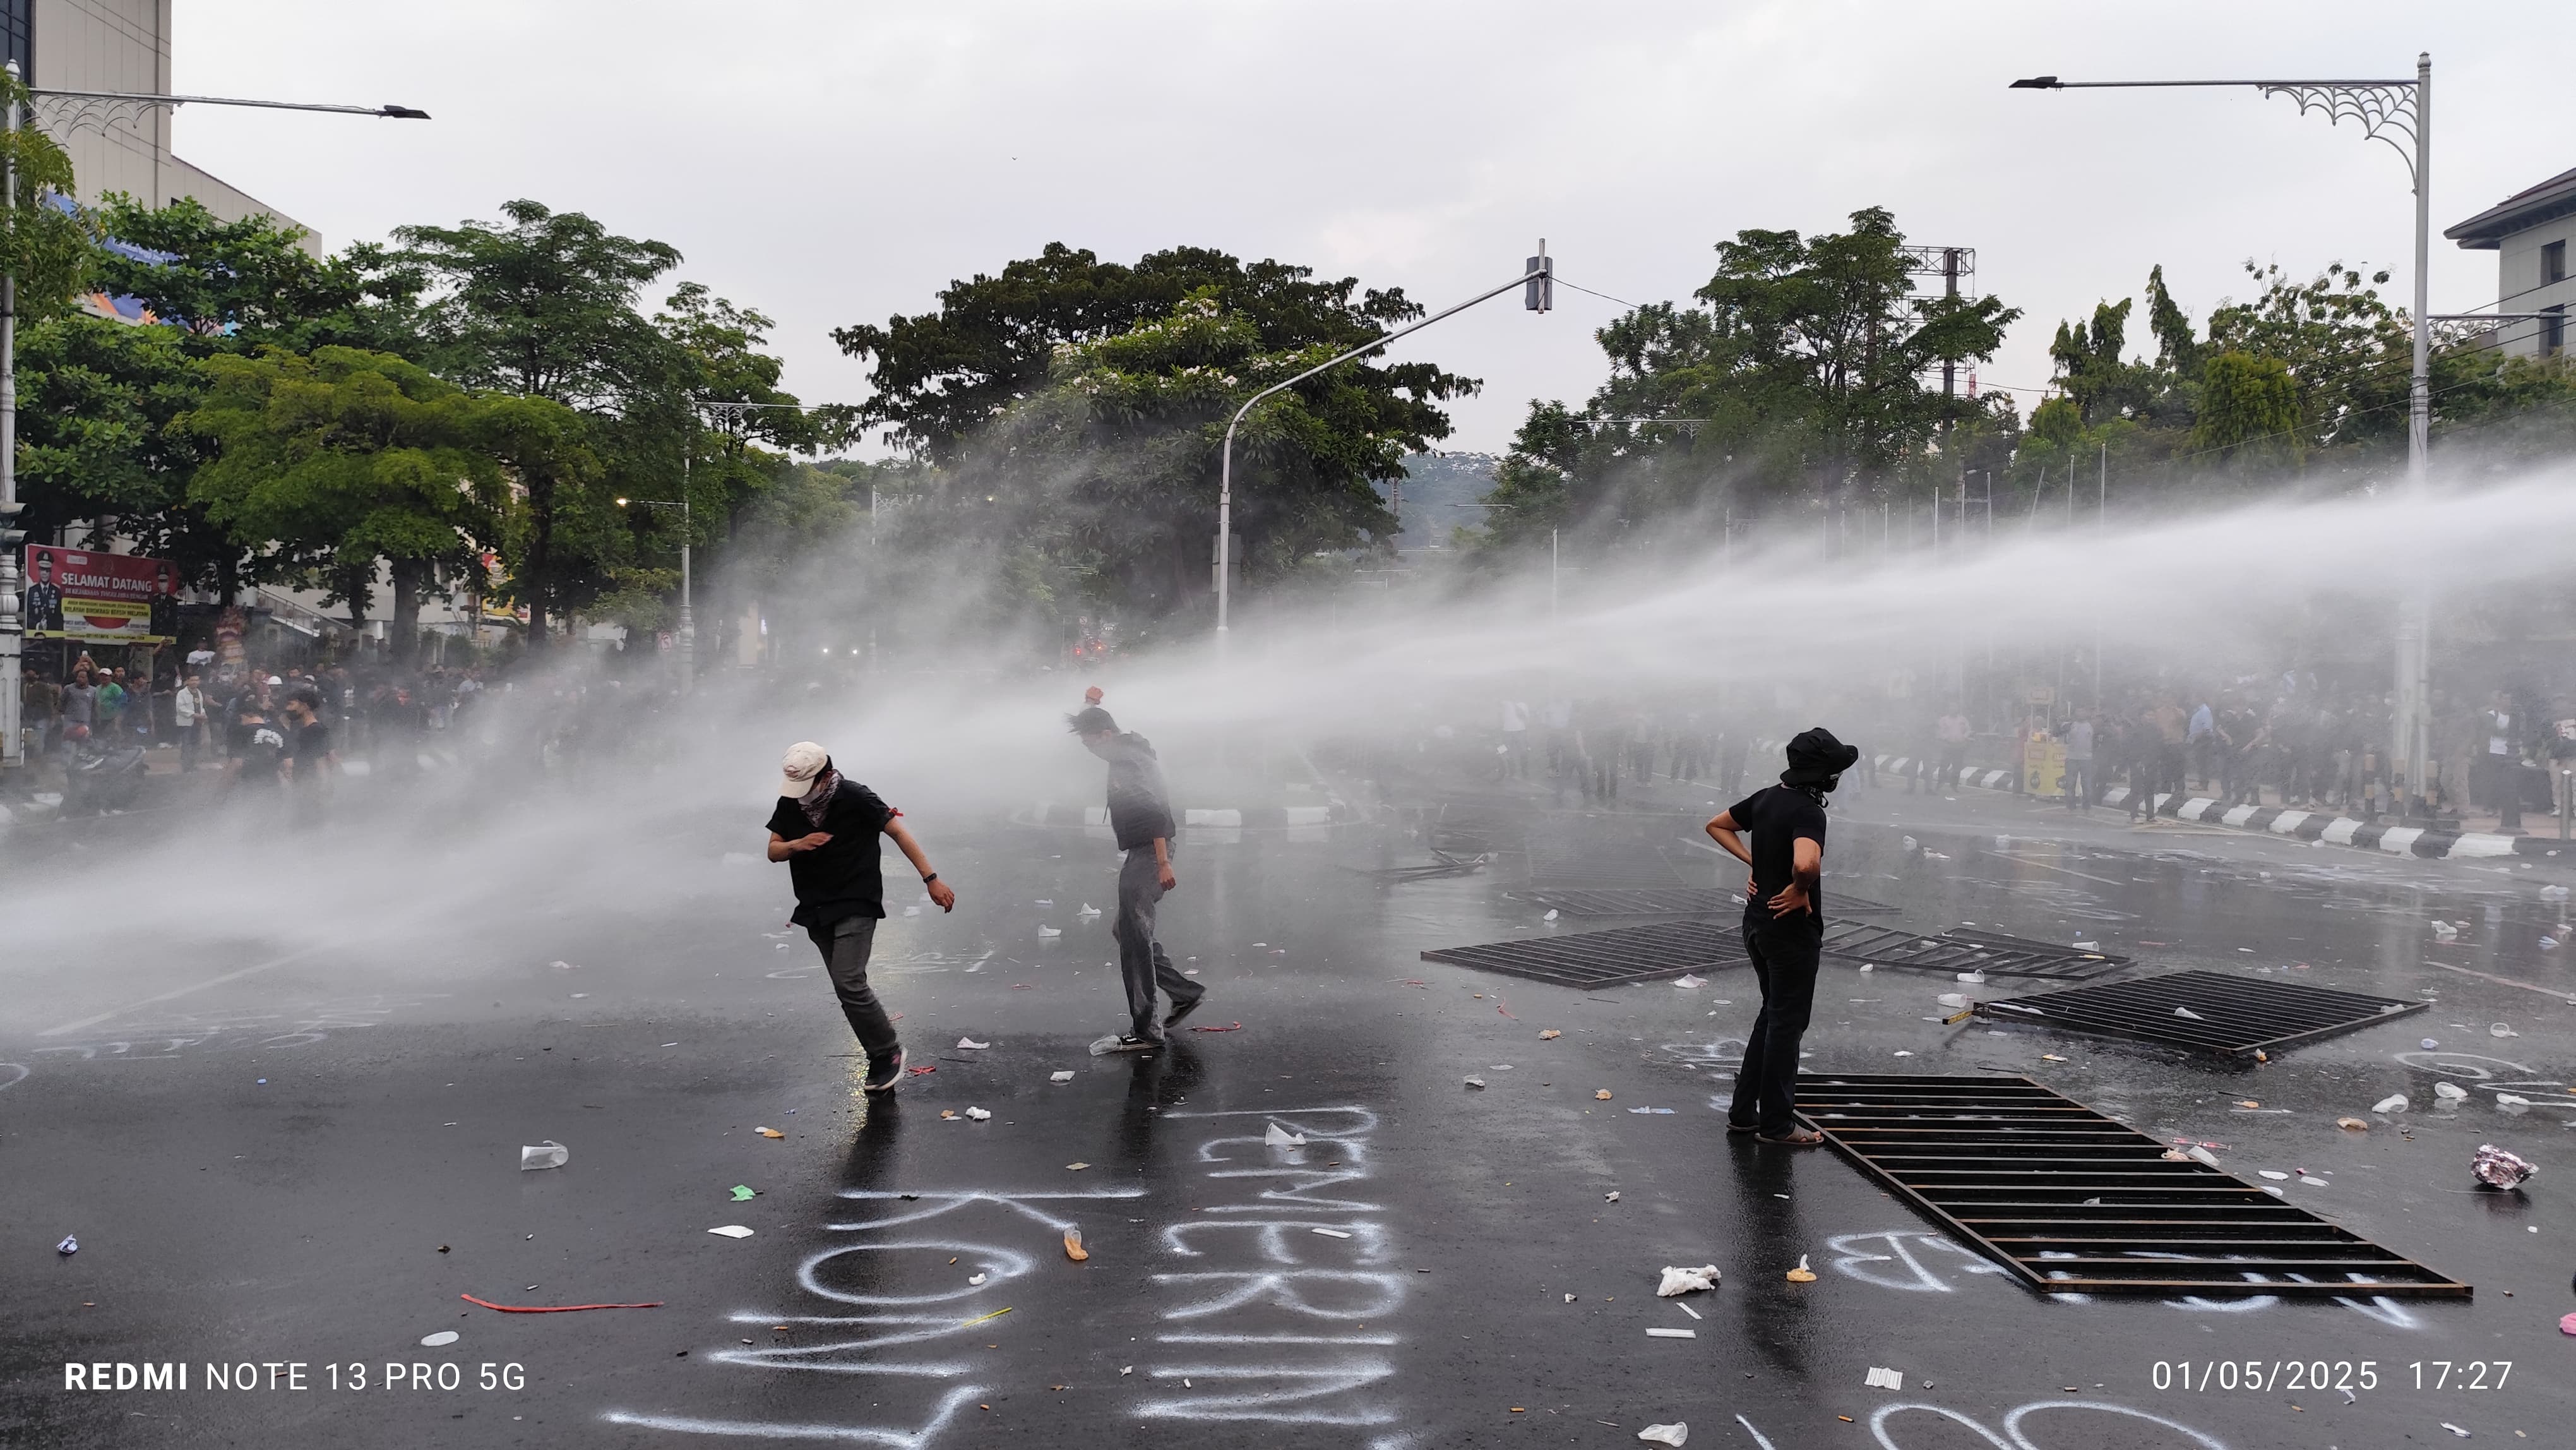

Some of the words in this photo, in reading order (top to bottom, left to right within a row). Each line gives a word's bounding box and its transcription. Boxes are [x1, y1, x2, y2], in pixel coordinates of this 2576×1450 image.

[61, 572, 110, 588] SELAMAT
[112, 577, 152, 592] DATANG
[1133, 1104, 1436, 1450] PEMERIN
